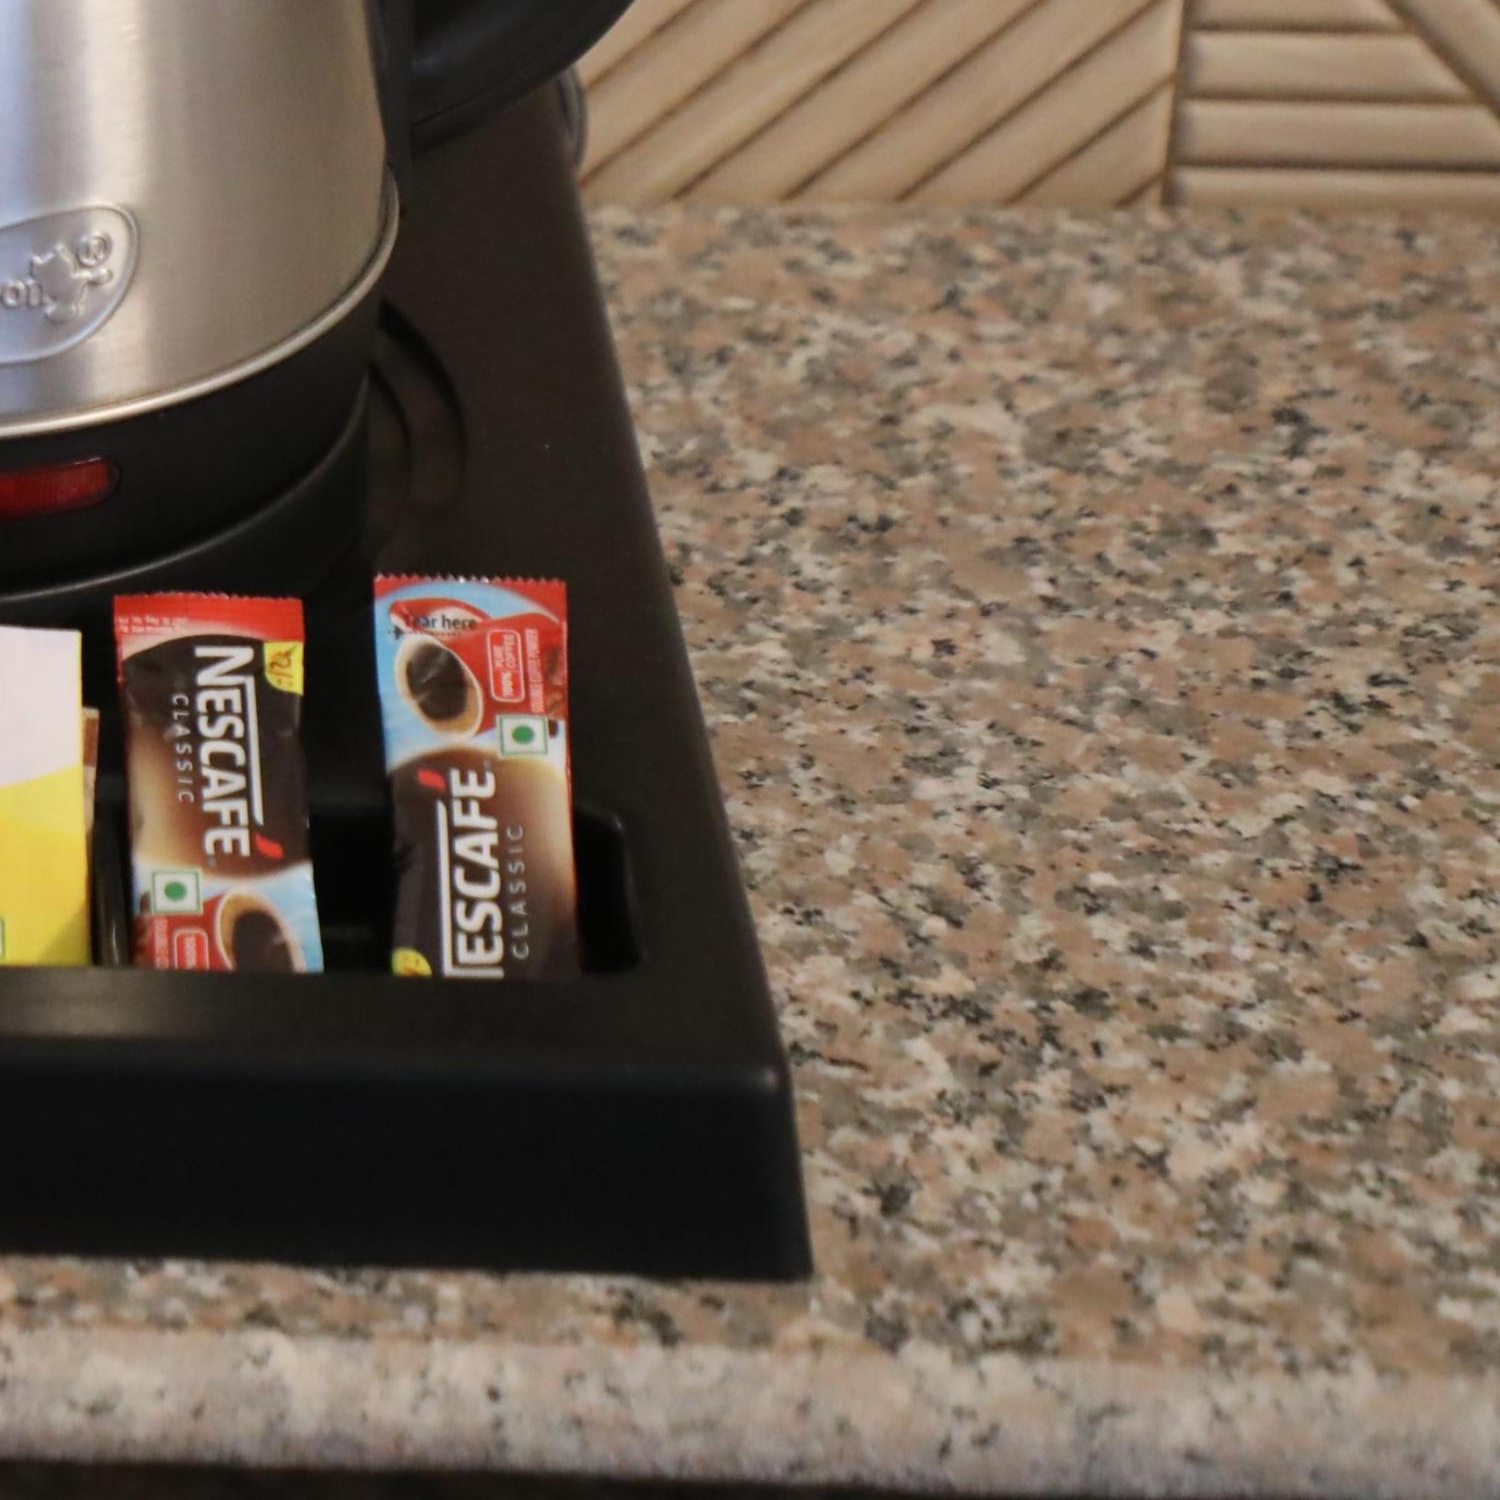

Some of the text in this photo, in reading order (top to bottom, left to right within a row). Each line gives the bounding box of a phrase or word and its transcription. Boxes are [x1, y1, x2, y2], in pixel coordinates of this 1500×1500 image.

[440, 613, 478, 630] here
[172, 692, 194, 804] CLASSIC
[507, 823, 530, 961] CLASSIC
